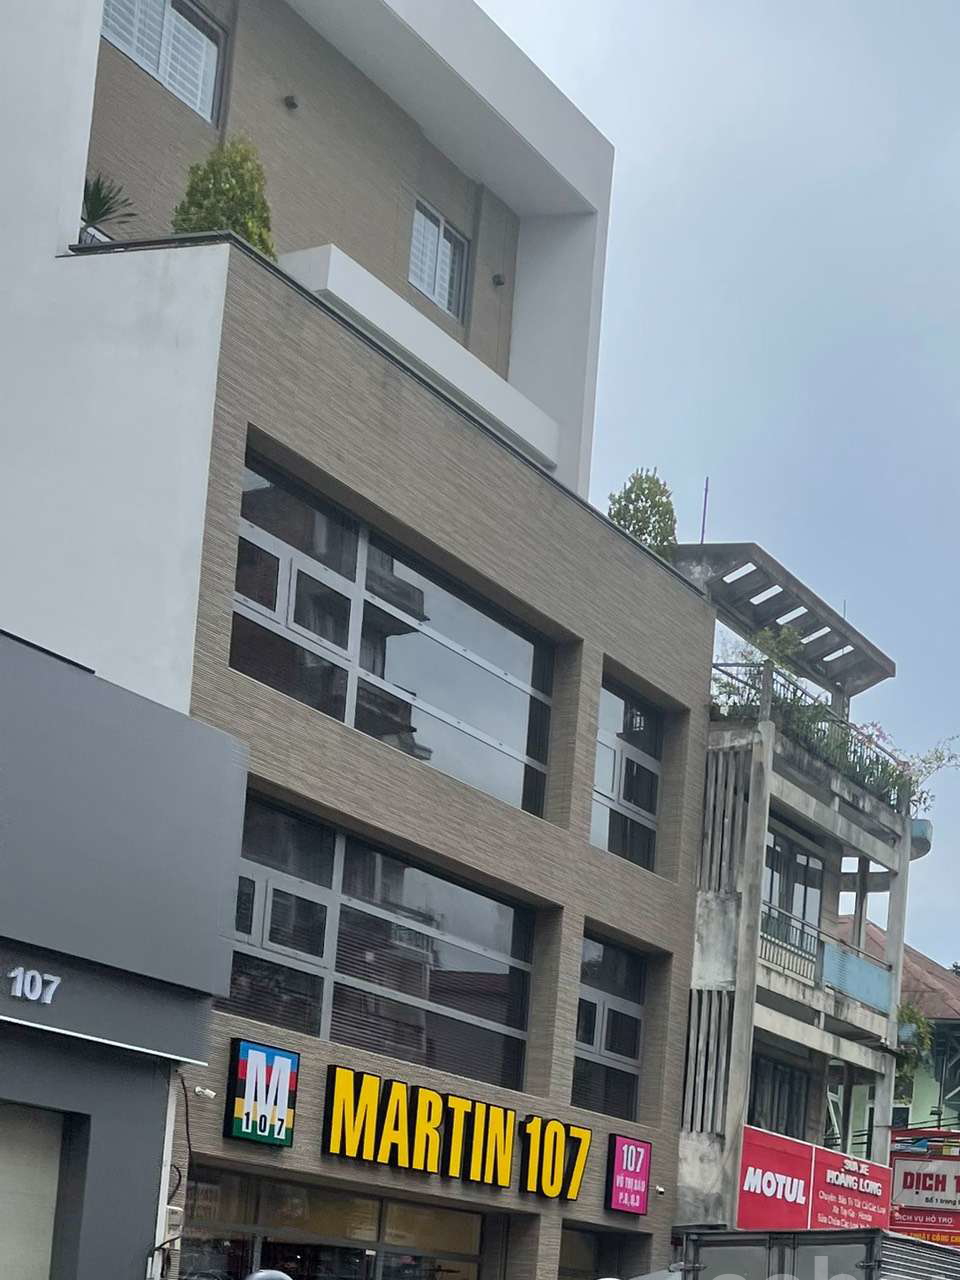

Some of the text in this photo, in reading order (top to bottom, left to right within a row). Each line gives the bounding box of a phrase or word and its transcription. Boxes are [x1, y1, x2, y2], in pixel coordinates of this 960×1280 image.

[7, 967, 61, 1004] 107
[242, 1050, 292, 1139] M
[244, 1111, 285, 1136] 107
[329, 1066, 592, 1200] MARTIN 107
[622, 1144, 645, 1173] 107
[743, 1167, 806, 1205] MOTUL
[903, 1171, 947, 1195] DỊCH
